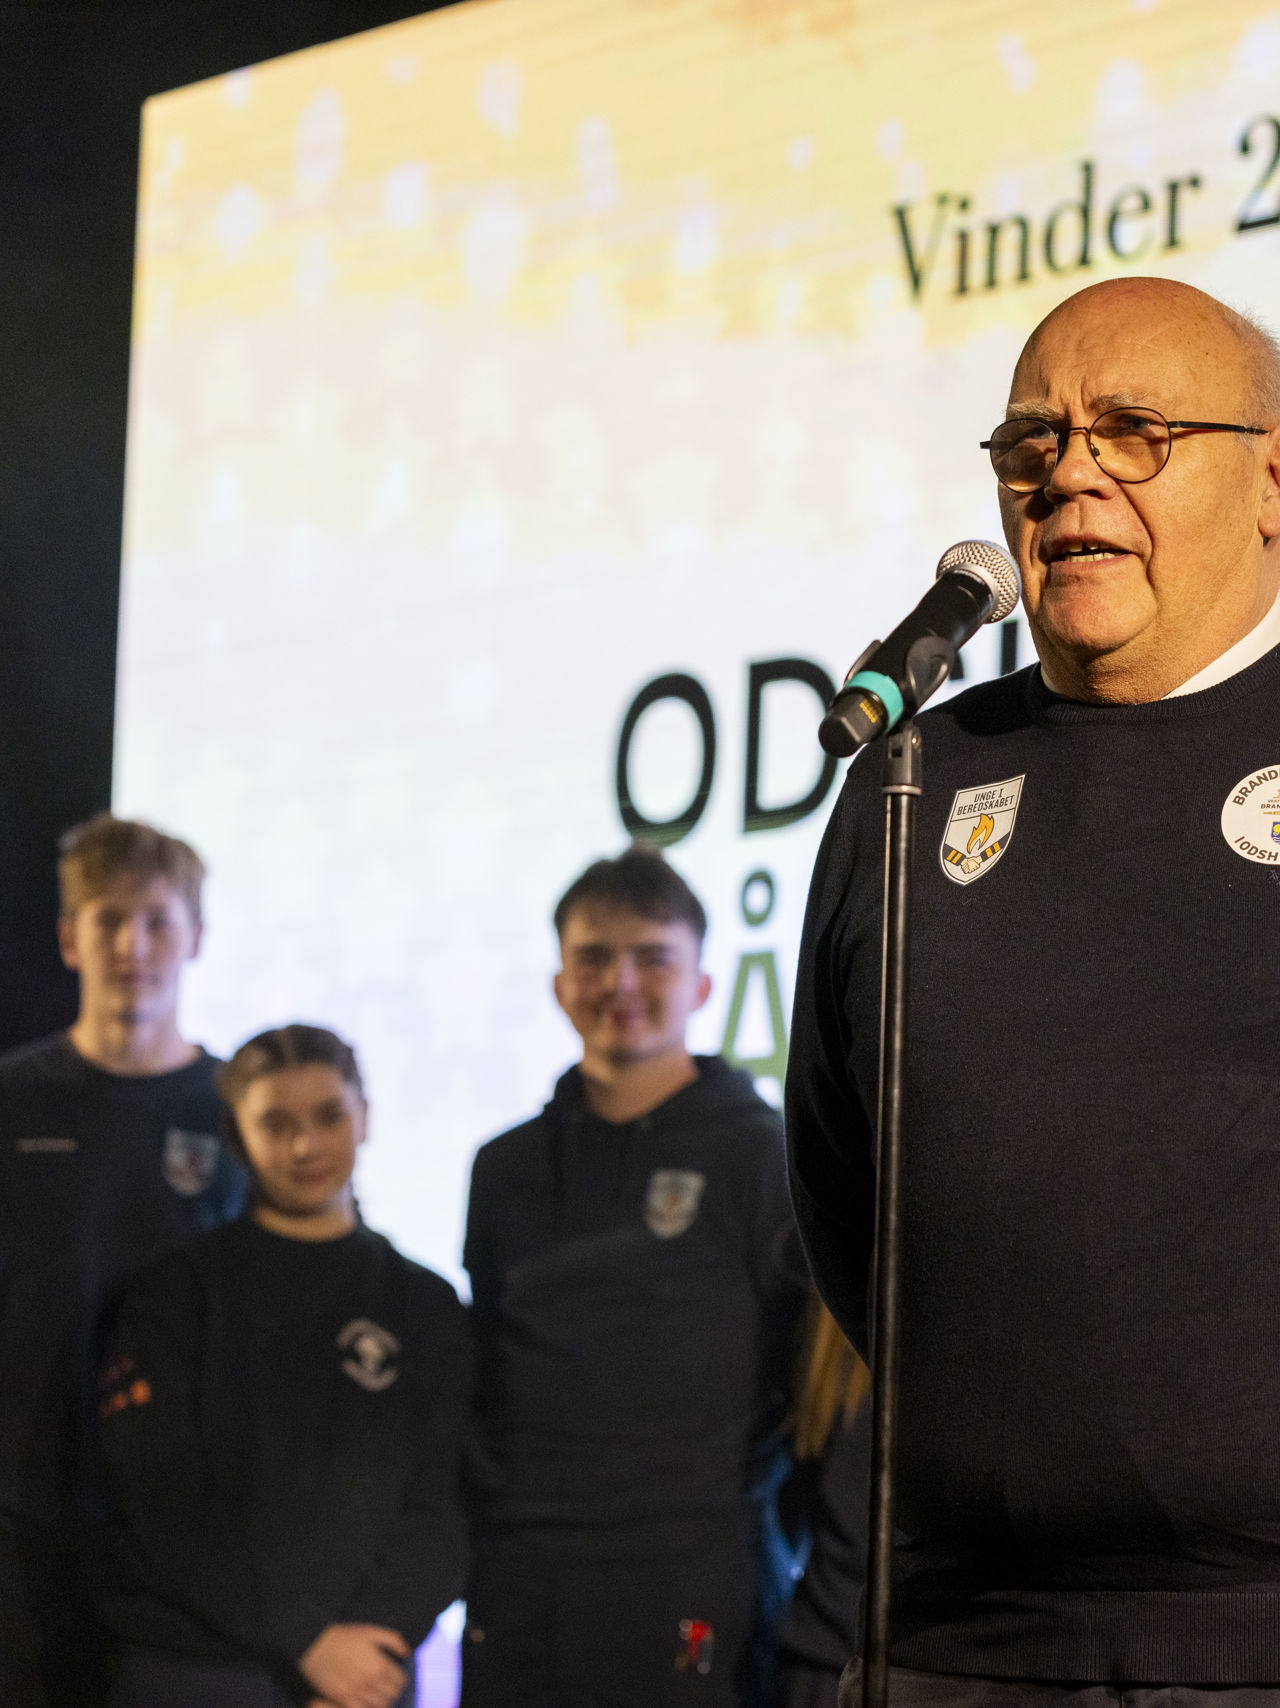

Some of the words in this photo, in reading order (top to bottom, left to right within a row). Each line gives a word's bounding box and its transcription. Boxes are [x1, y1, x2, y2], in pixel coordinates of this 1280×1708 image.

[892, 155, 1205, 303] Vinder
[957, 795, 1015, 816] BEREDSKABET
[974, 789, 997, 803] UNGE
[998, 788, 1004, 798] I
